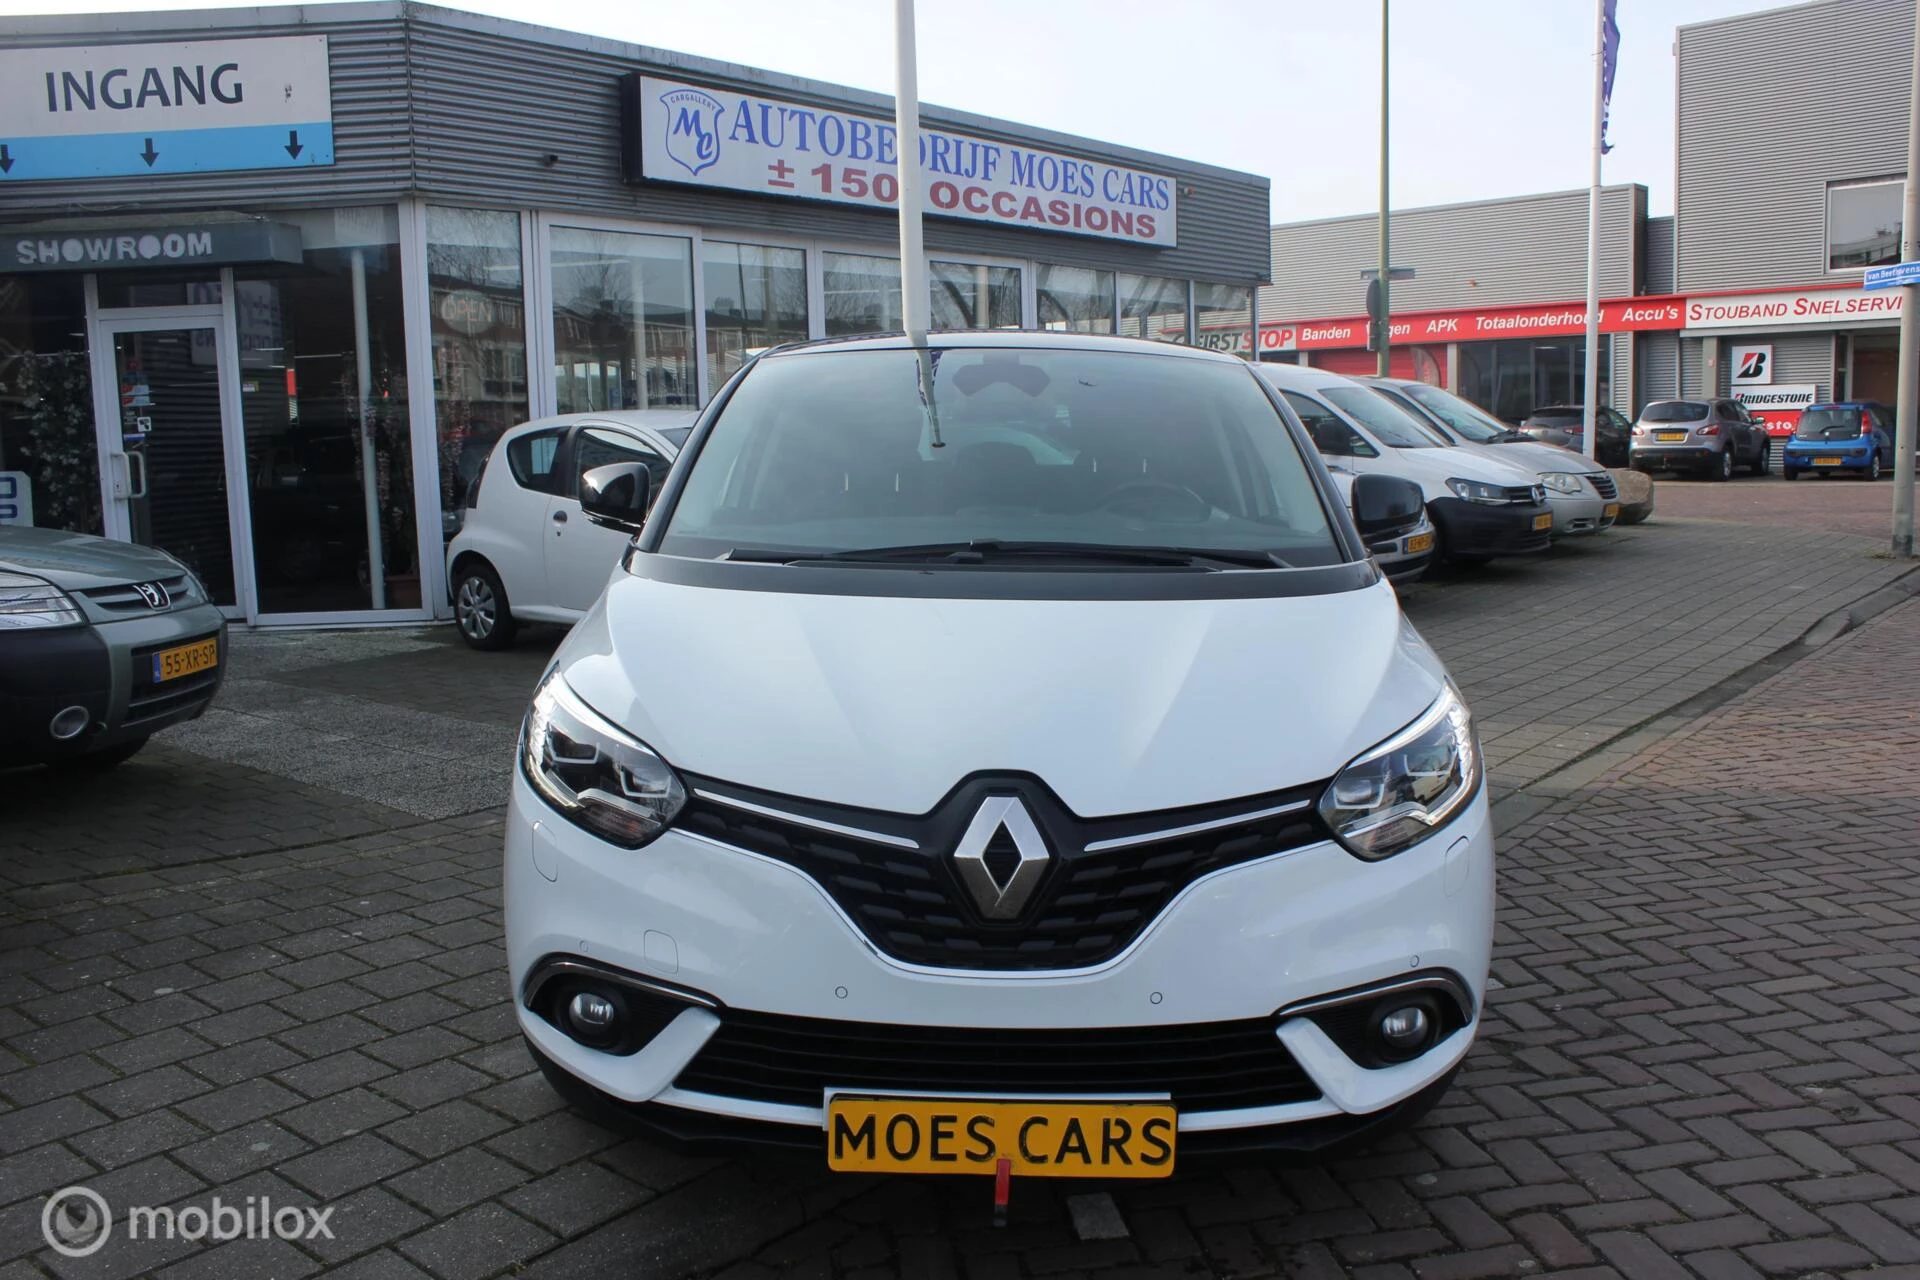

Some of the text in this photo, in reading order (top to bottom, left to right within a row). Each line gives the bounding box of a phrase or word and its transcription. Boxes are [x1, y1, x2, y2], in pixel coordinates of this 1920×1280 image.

[46, 63, 244, 113] INGANG
[670, 94, 715, 112] CARGALLERY
[728, 100, 1170, 211] AUTOBERIJF MOES CARS
[811, 163, 899, 203] 150
[929, 181, 1157, 239] OCCASIONS
[16, 231, 213, 265] SHOWROOM
[1302, 325, 1351, 342] Banden
[1426, 318, 1459, 334] APK
[1622, 305, 1679, 322] Accu's
[1689, 296, 1903, 321] STOUBAND SNELSERVI
[1735, 393, 1813, 405] BRIDGESTONE
[165, 643, 215, 676] 55-XR-SP
[834, 1113, 1172, 1167] MOES CARS
